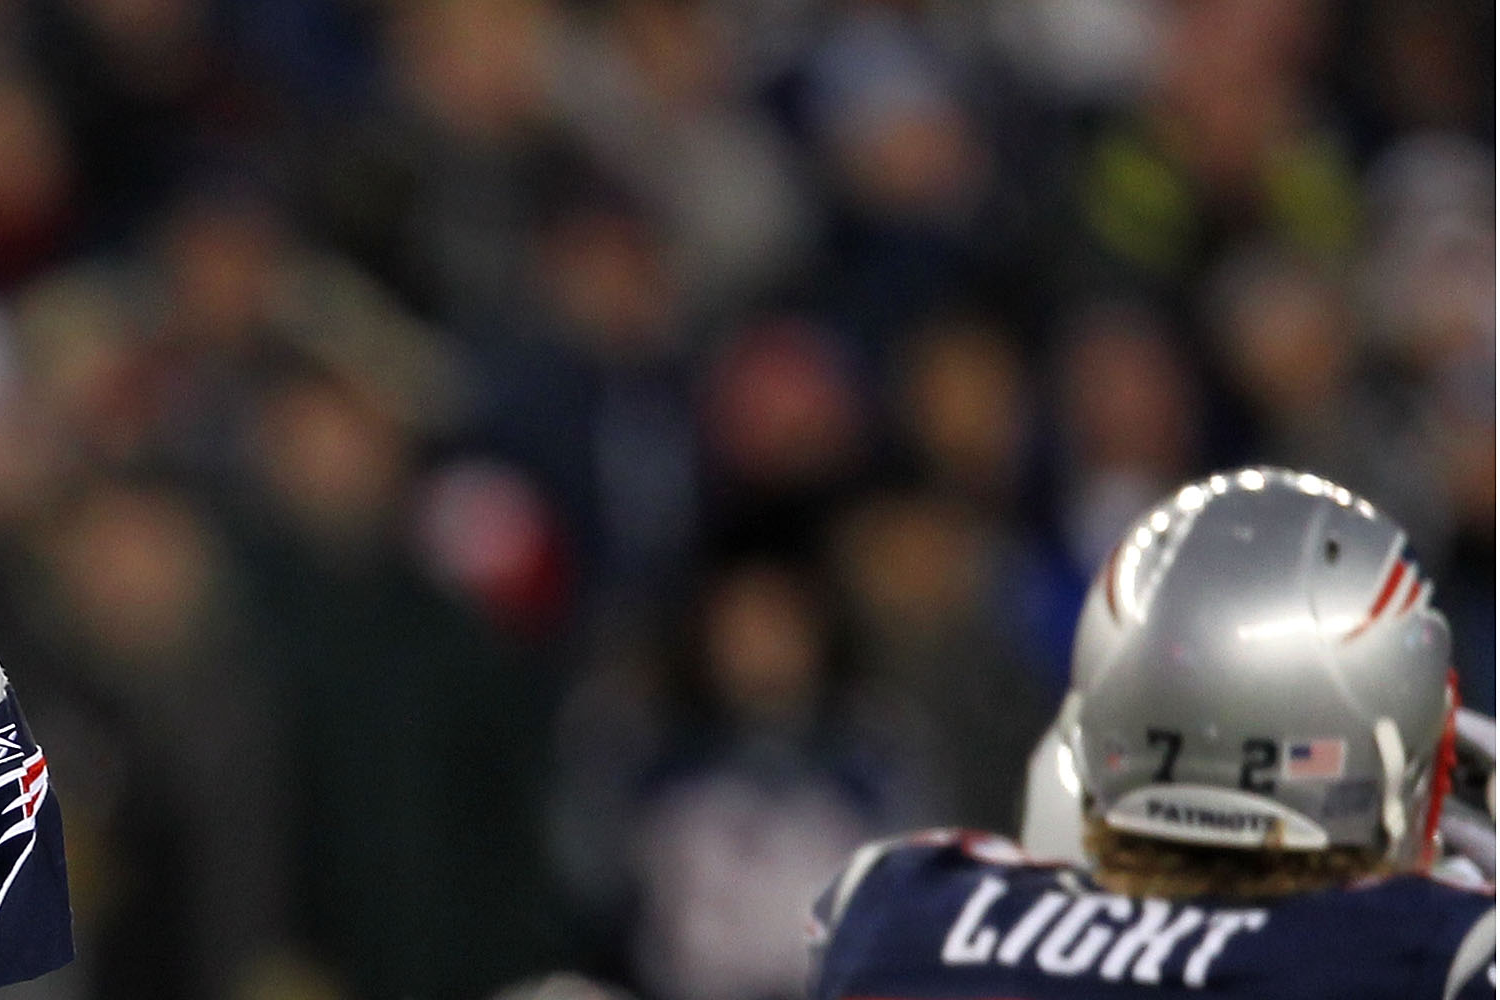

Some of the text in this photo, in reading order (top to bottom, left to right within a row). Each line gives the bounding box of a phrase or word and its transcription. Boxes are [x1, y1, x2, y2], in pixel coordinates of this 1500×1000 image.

[1146, 728, 1277, 796] 7 2
[941, 875, 1270, 988] LIGHT
